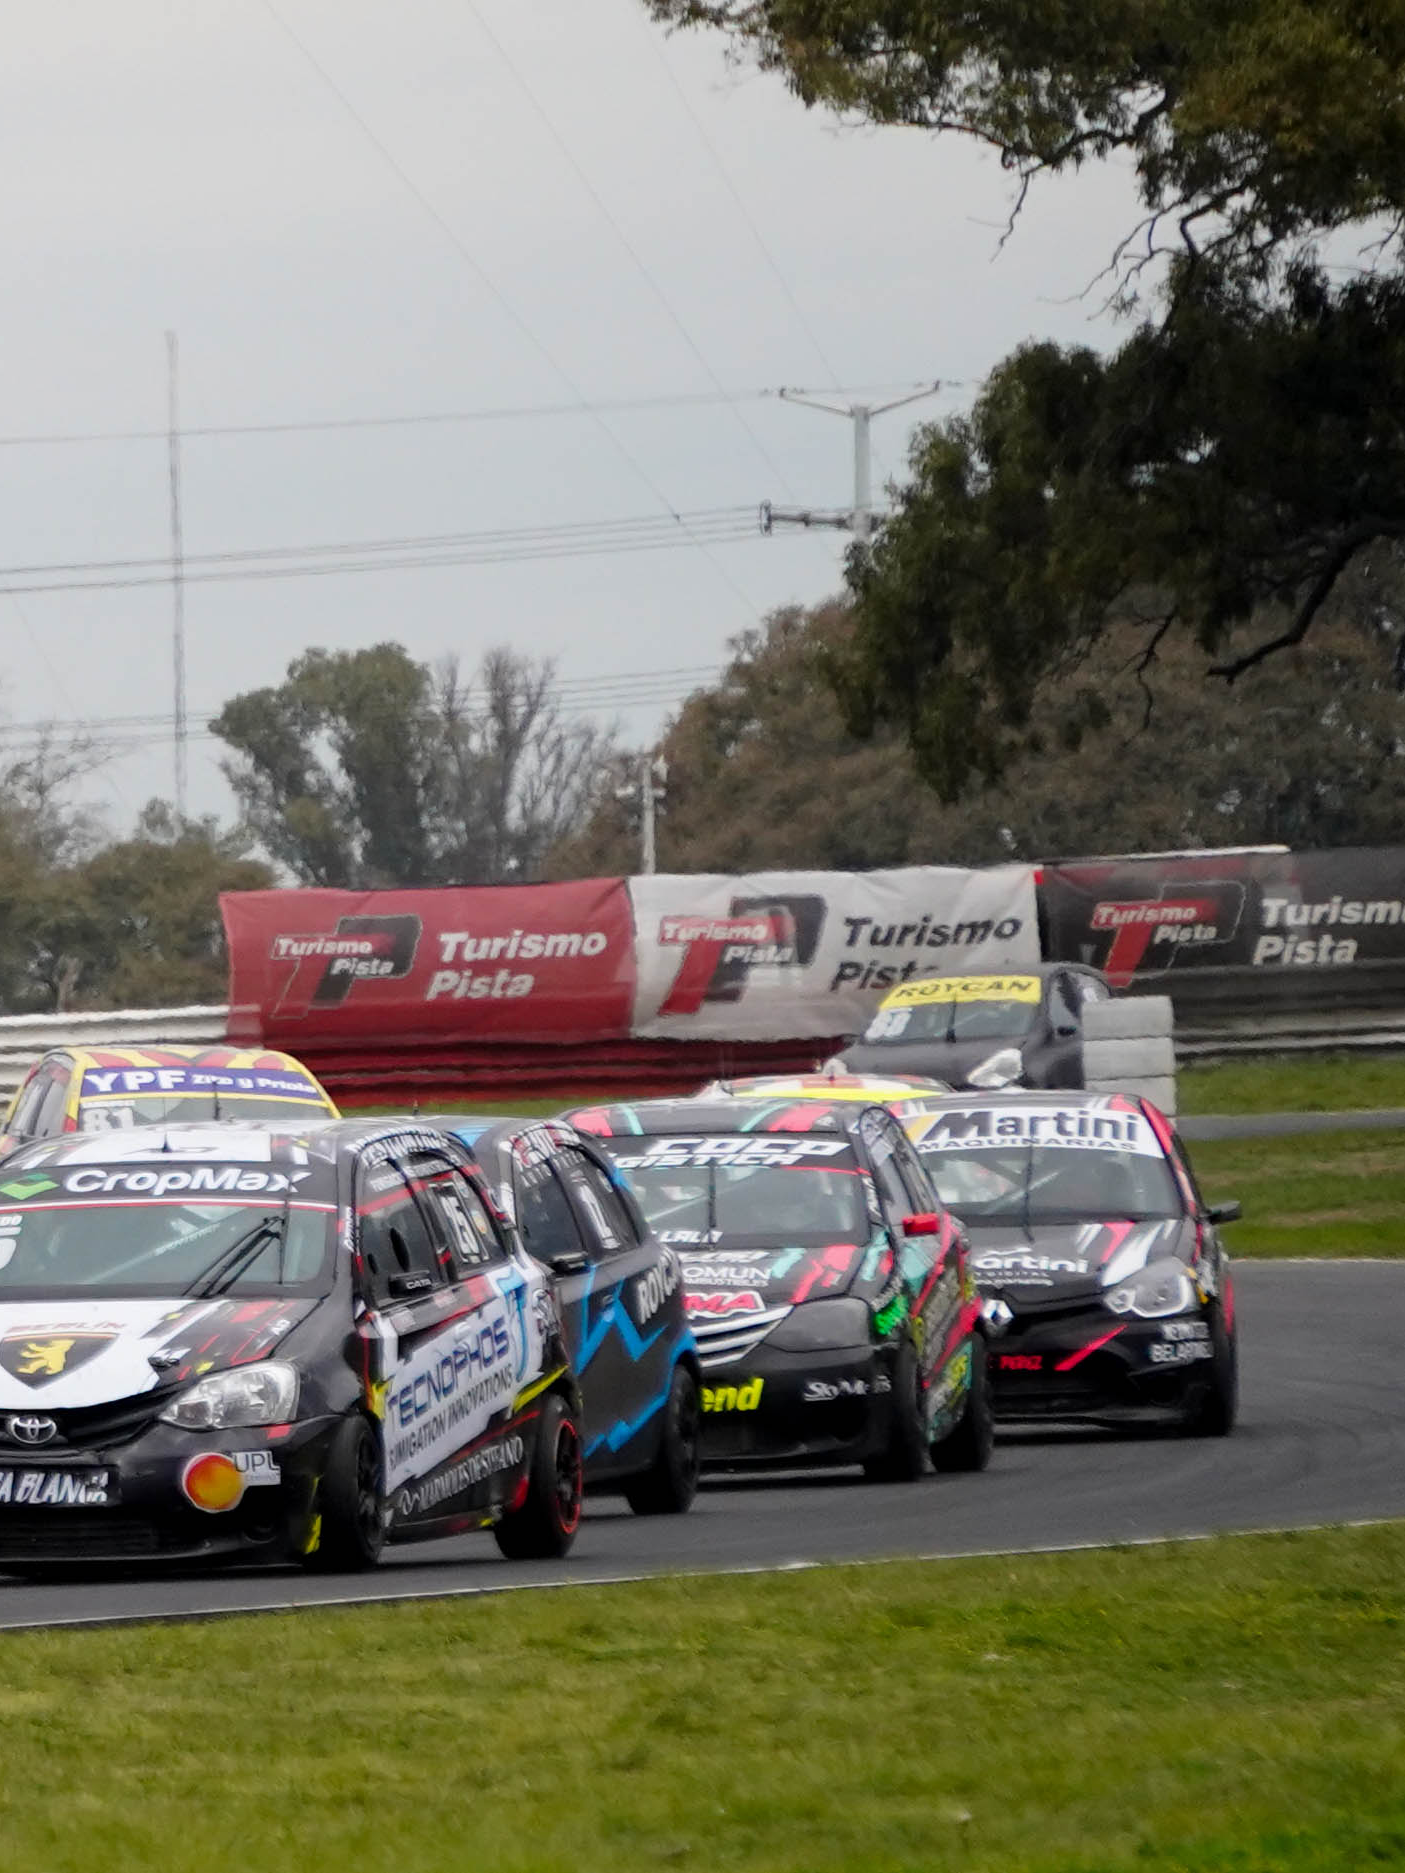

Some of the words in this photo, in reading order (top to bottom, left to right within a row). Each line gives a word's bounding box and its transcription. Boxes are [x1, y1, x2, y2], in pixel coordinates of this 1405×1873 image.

[1098, 905, 1198, 925] Turismo
[663, 921, 770, 942] Turismo
[843, 913, 1023, 948] Turismo
[1153, 924, 1218, 945] Pista
[277, 938, 374, 957] Turismo
[439, 930, 608, 962] Turismo
[723, 945, 795, 964] Pista
[1253, 934, 1359, 966] Pista
[330, 958, 394, 976] Pista
[829, 959, 941, 993] Pist
[426, 968, 535, 1001] Pista
[85, 1070, 186, 1092] YPF
[922, 1110, 1139, 1142] Martini
[917, 1137, 1137, 1150] MAQUINARIAS
[65, 1168, 312, 1197] CropMax
[682, 1266, 772, 1280] OMUN
[974, 1256, 1088, 1273] artini
[386, 1316, 511, 1428] TECNOPHOS
[700, 1377, 765, 1413] end
[234, 1452, 278, 1473] UPL
